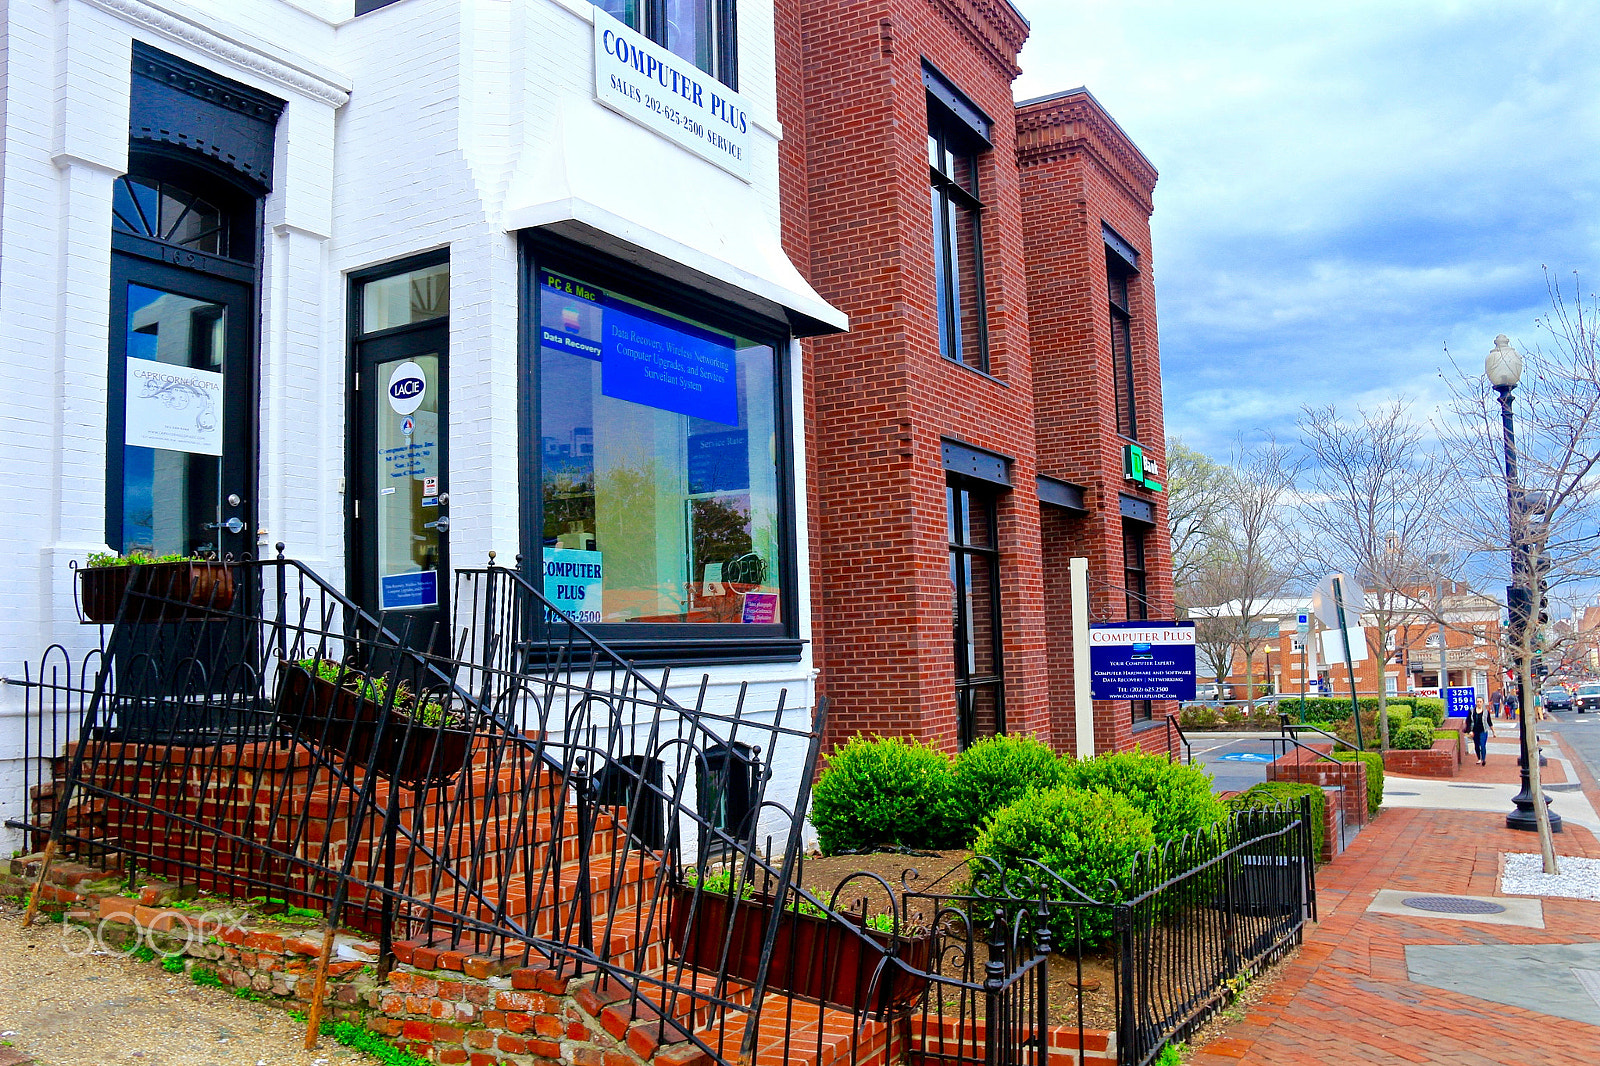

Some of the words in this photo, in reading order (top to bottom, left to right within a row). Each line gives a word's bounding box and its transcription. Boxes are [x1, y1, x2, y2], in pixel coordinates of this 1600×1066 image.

[603, 29, 704, 108] COMPUTER
[711, 92, 747, 134] PLUS
[610, 73, 641, 103] SALES
[645, 94, 704, 139] 202-625-2500
[707, 129, 742, 161] SERVICE
[161, 247, 207, 270] 1621
[548, 276, 562, 290] PC
[565, 282, 573, 294] &
[576, 285, 596, 301] Mac
[543, 331, 563, 344] Data
[565, 337, 602, 356] Recovery
[611, 324, 629, 340] Data
[666, 341, 692, 359] Wireless
[694, 351, 729, 373] Networking
[616, 342, 652, 362] Computer
[687, 366, 699, 376] and
[699, 367, 725, 383] Services
[679, 376, 702, 392] System
[1143, 455, 1158, 475] Bank
[557, 585, 586, 600] PLUS
[1092, 631, 1160, 643] COMPUTER
[1163, 631, 1192, 641] PLUS
